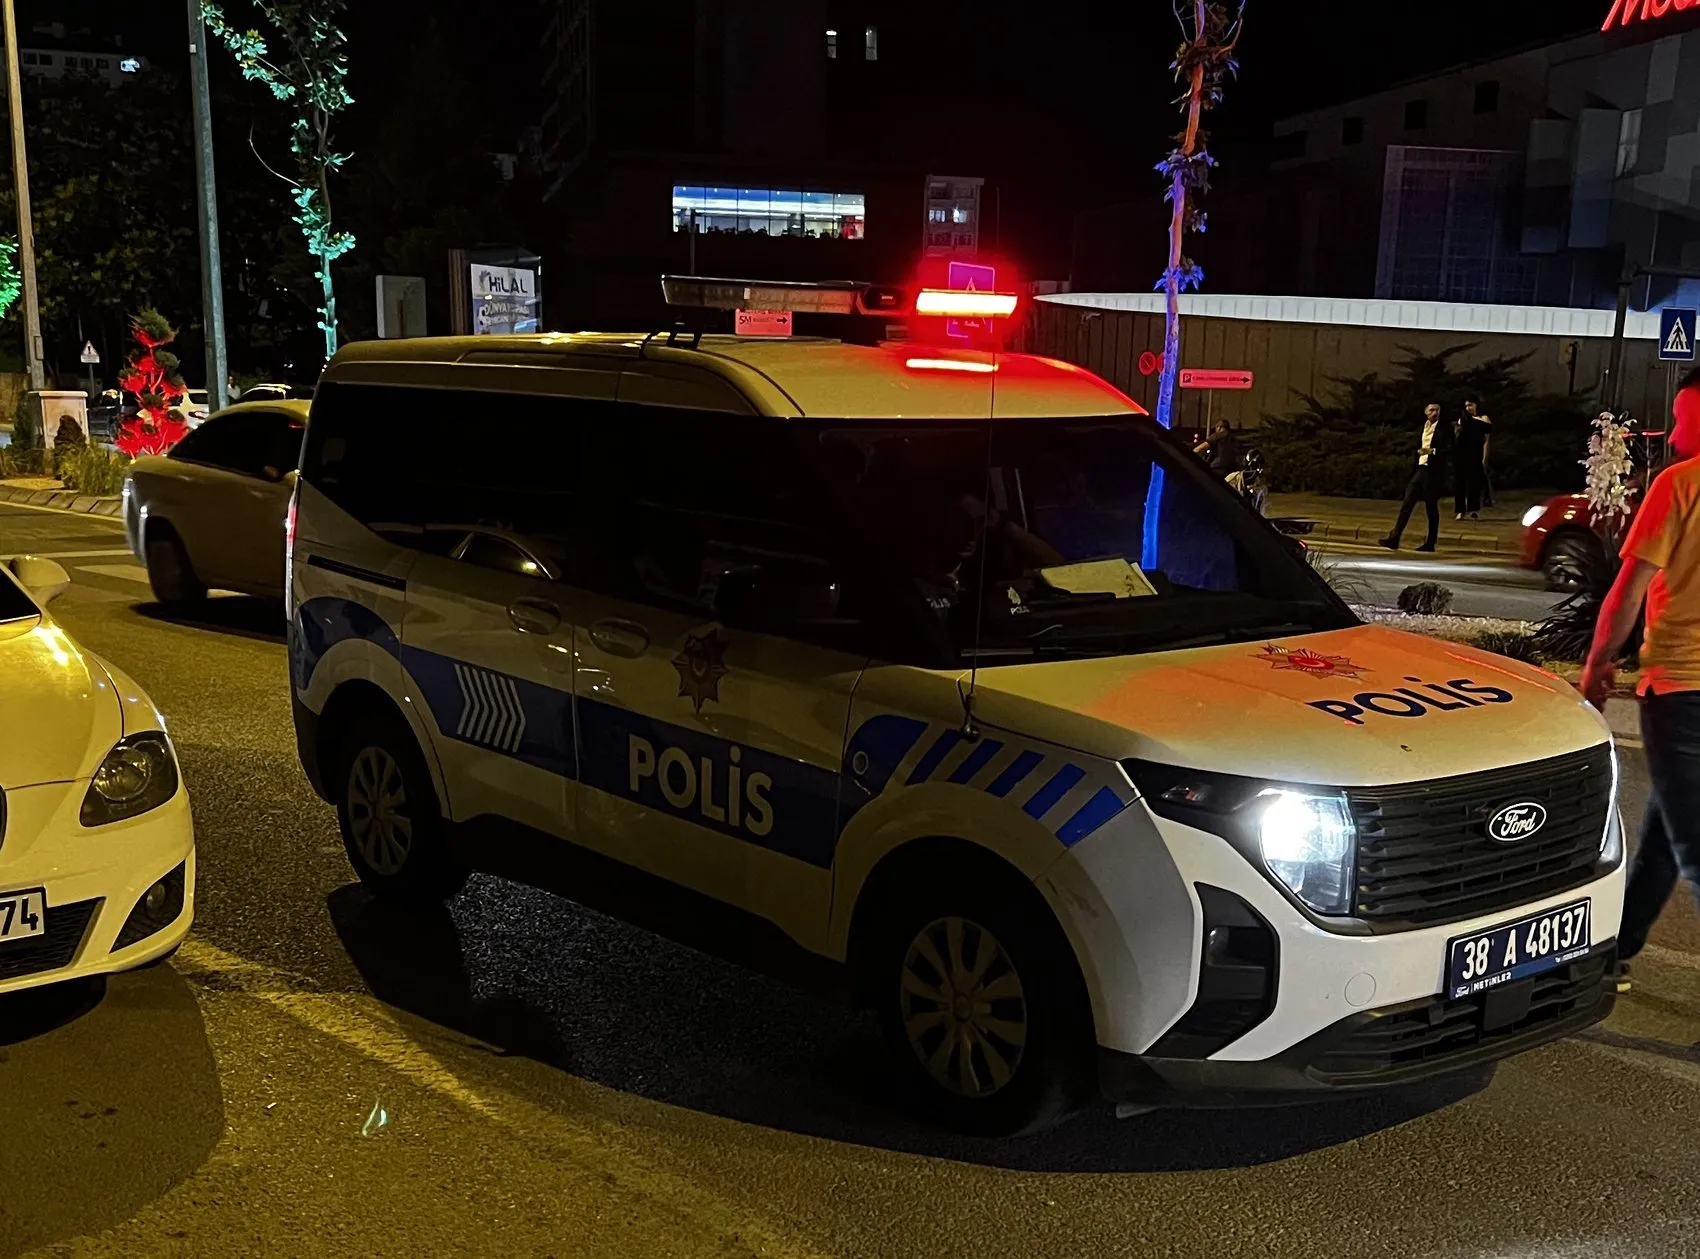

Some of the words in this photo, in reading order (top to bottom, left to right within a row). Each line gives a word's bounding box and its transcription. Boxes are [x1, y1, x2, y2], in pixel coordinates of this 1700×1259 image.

[1304, 676, 1513, 724] POLİS
[629, 733, 773, 836] POLİS
[1501, 807, 1537, 837] Ford
[0, 897, 39, 936] 74
[1462, 937, 1490, 980] 38
[1503, 928, 1517, 967] A
[1525, 906, 1585, 958] 48137
